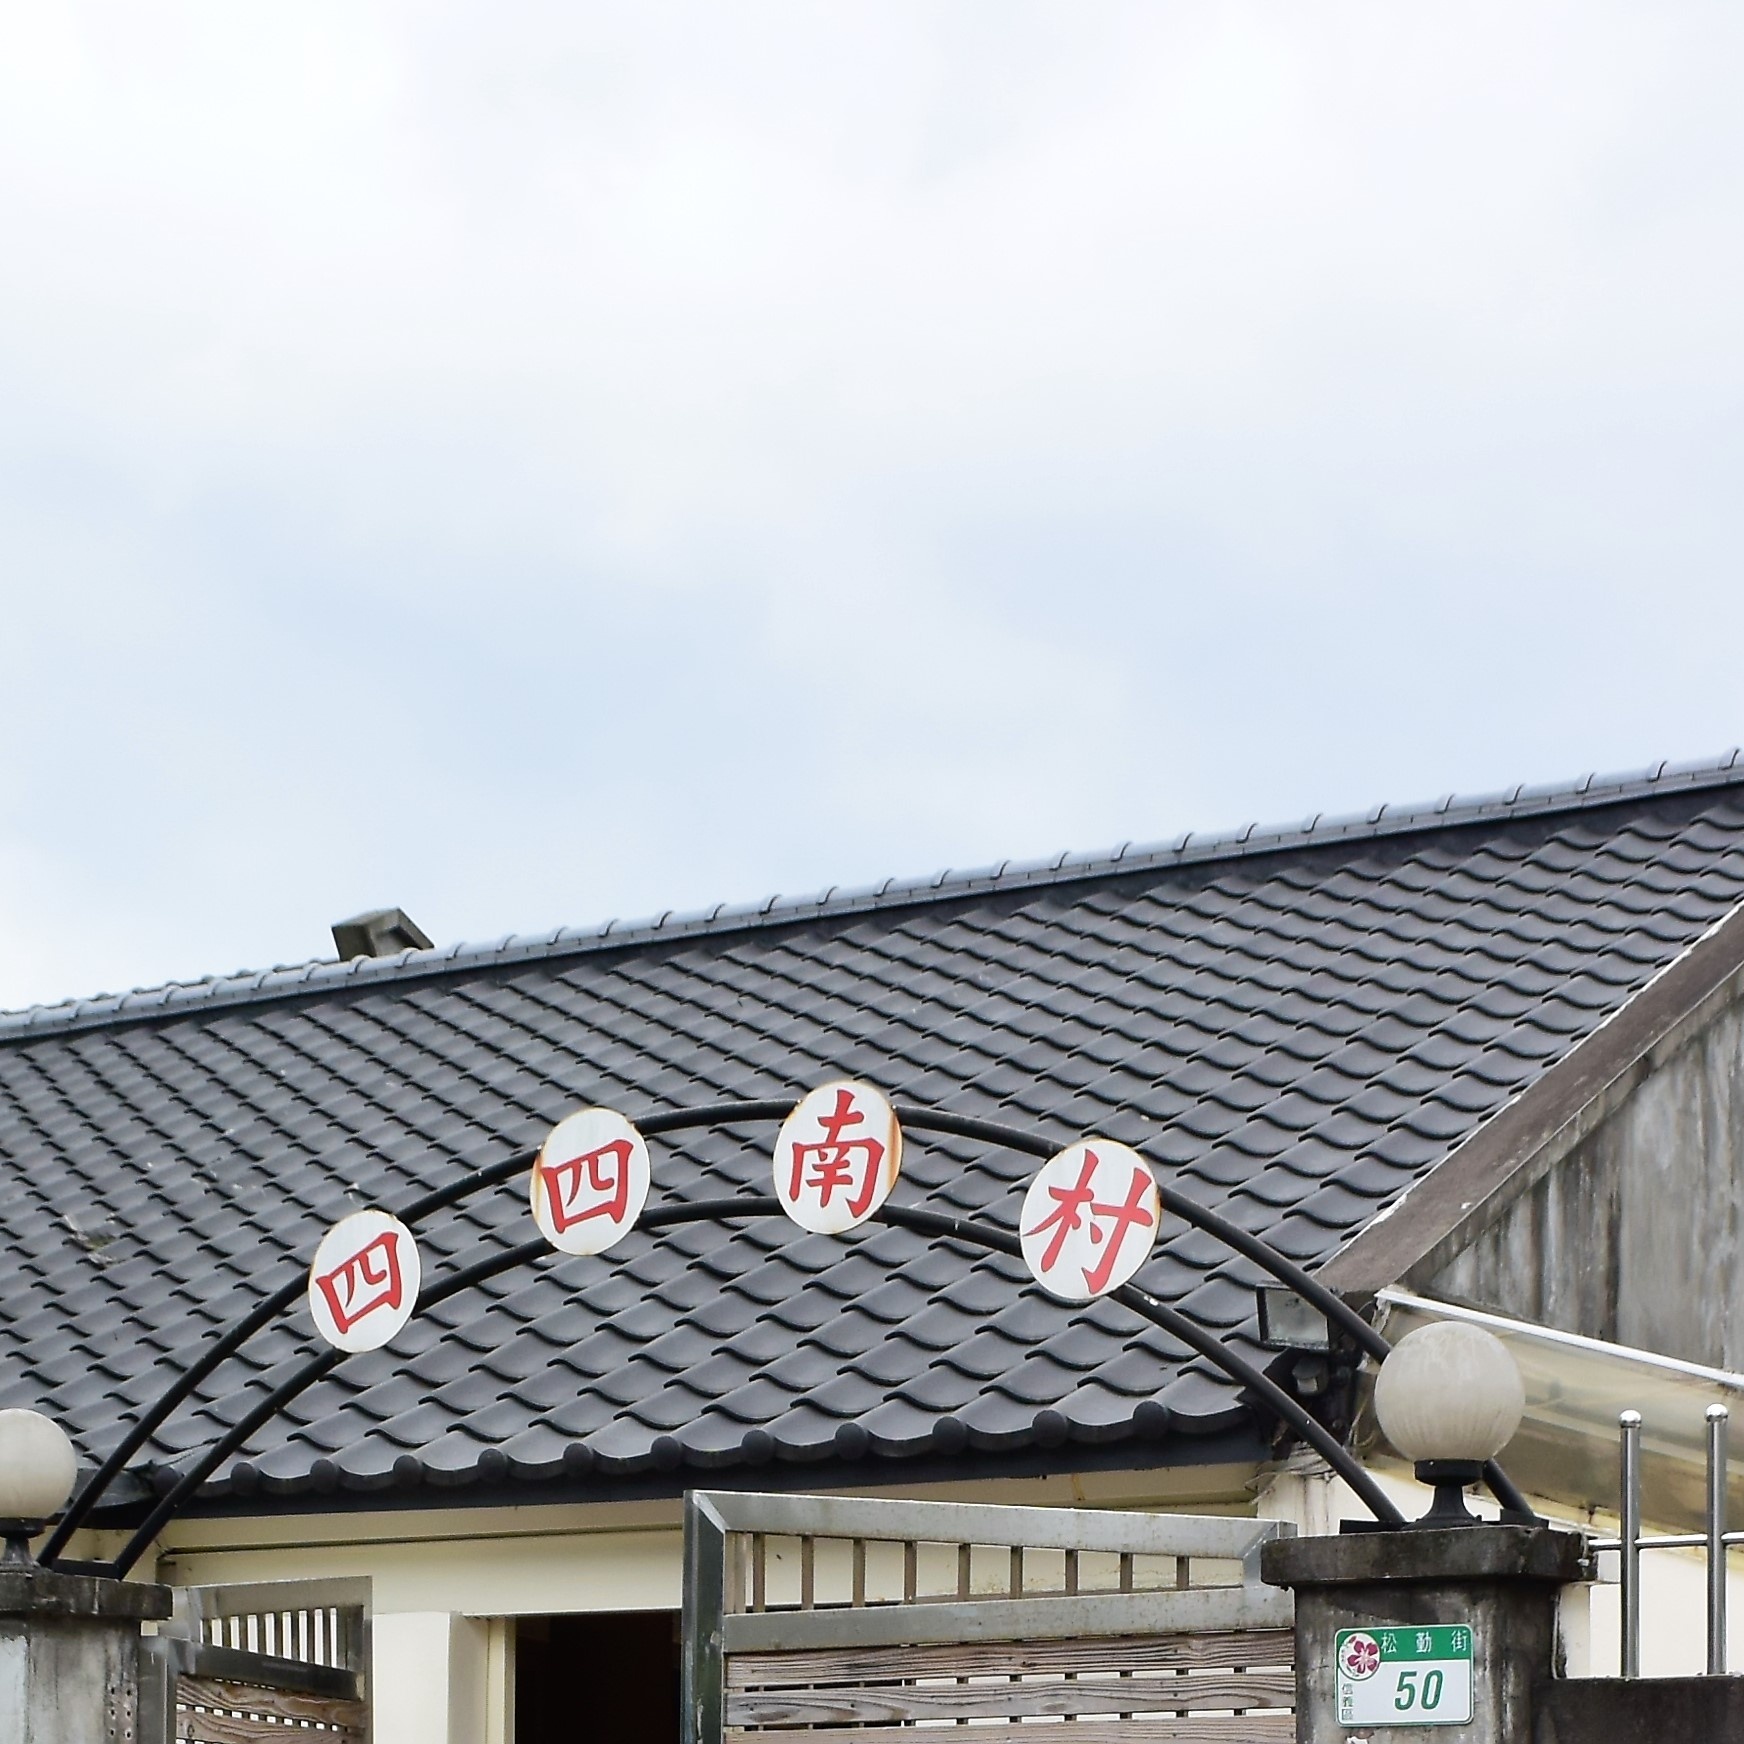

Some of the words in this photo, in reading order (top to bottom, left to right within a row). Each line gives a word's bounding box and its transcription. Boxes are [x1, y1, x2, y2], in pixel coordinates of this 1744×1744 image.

[316, 1088, 1156, 1334] 四四南村
[1381, 1630, 1468, 1653] 松勤街
[1394, 1669, 1443, 1711] 50
